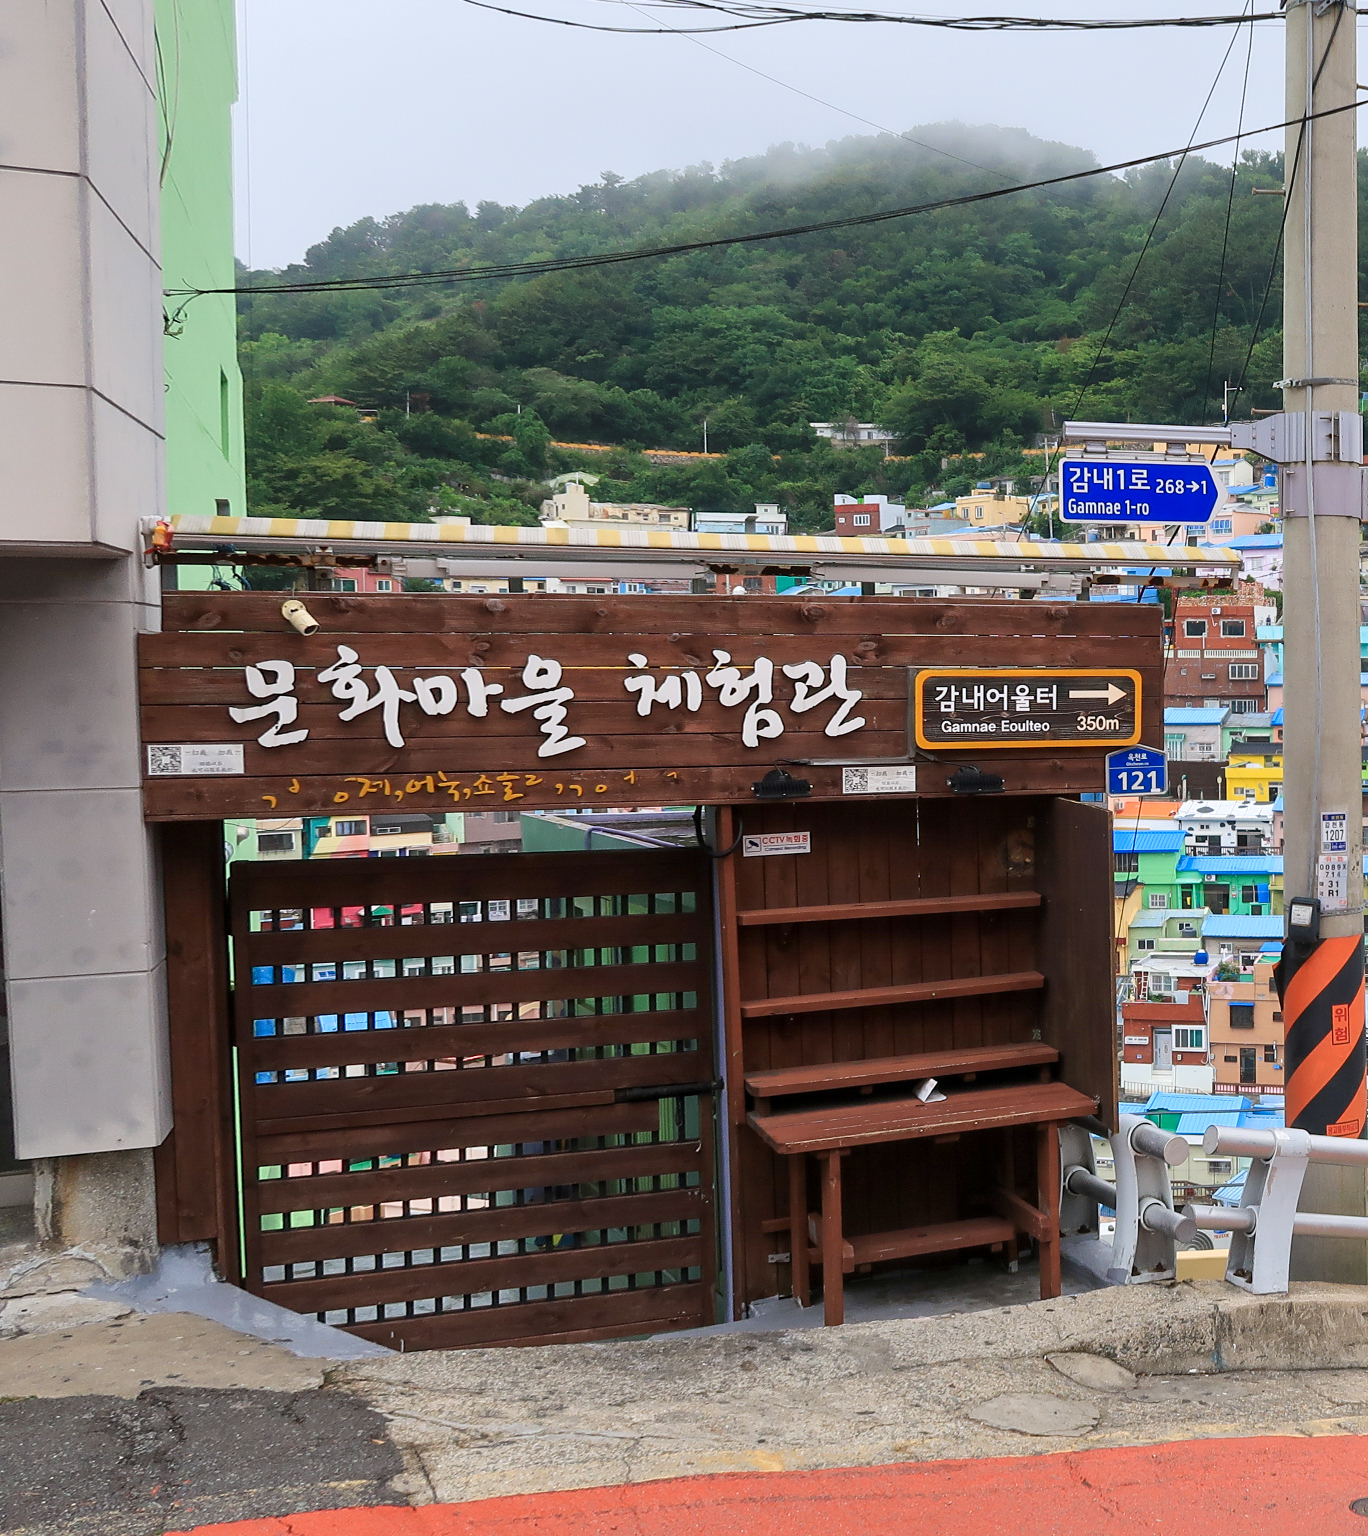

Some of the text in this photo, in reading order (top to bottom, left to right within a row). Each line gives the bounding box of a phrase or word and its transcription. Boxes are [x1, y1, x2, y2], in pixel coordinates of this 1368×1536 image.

[1069, 467, 1150, 493] 감내1로
[1155, 479, 1184, 494] 268
[1068, 499, 1150, 515] Gamnae 1-ro
[228, 645, 866, 757] 문화마을 체험관
[934, 684, 1058, 712] 감내어울터
[941, 715, 1120, 733] Gamnae Eoulteo 350m
[1117, 770, 1157, 791] 121
[762, 836, 785, 845] CCTV
[1325, 830, 1344, 841] 1207
[1328, 880, 1339, 888] 31
[1328, 889, 1339, 897] R1
[1335, 1007, 1348, 1041] 위험
